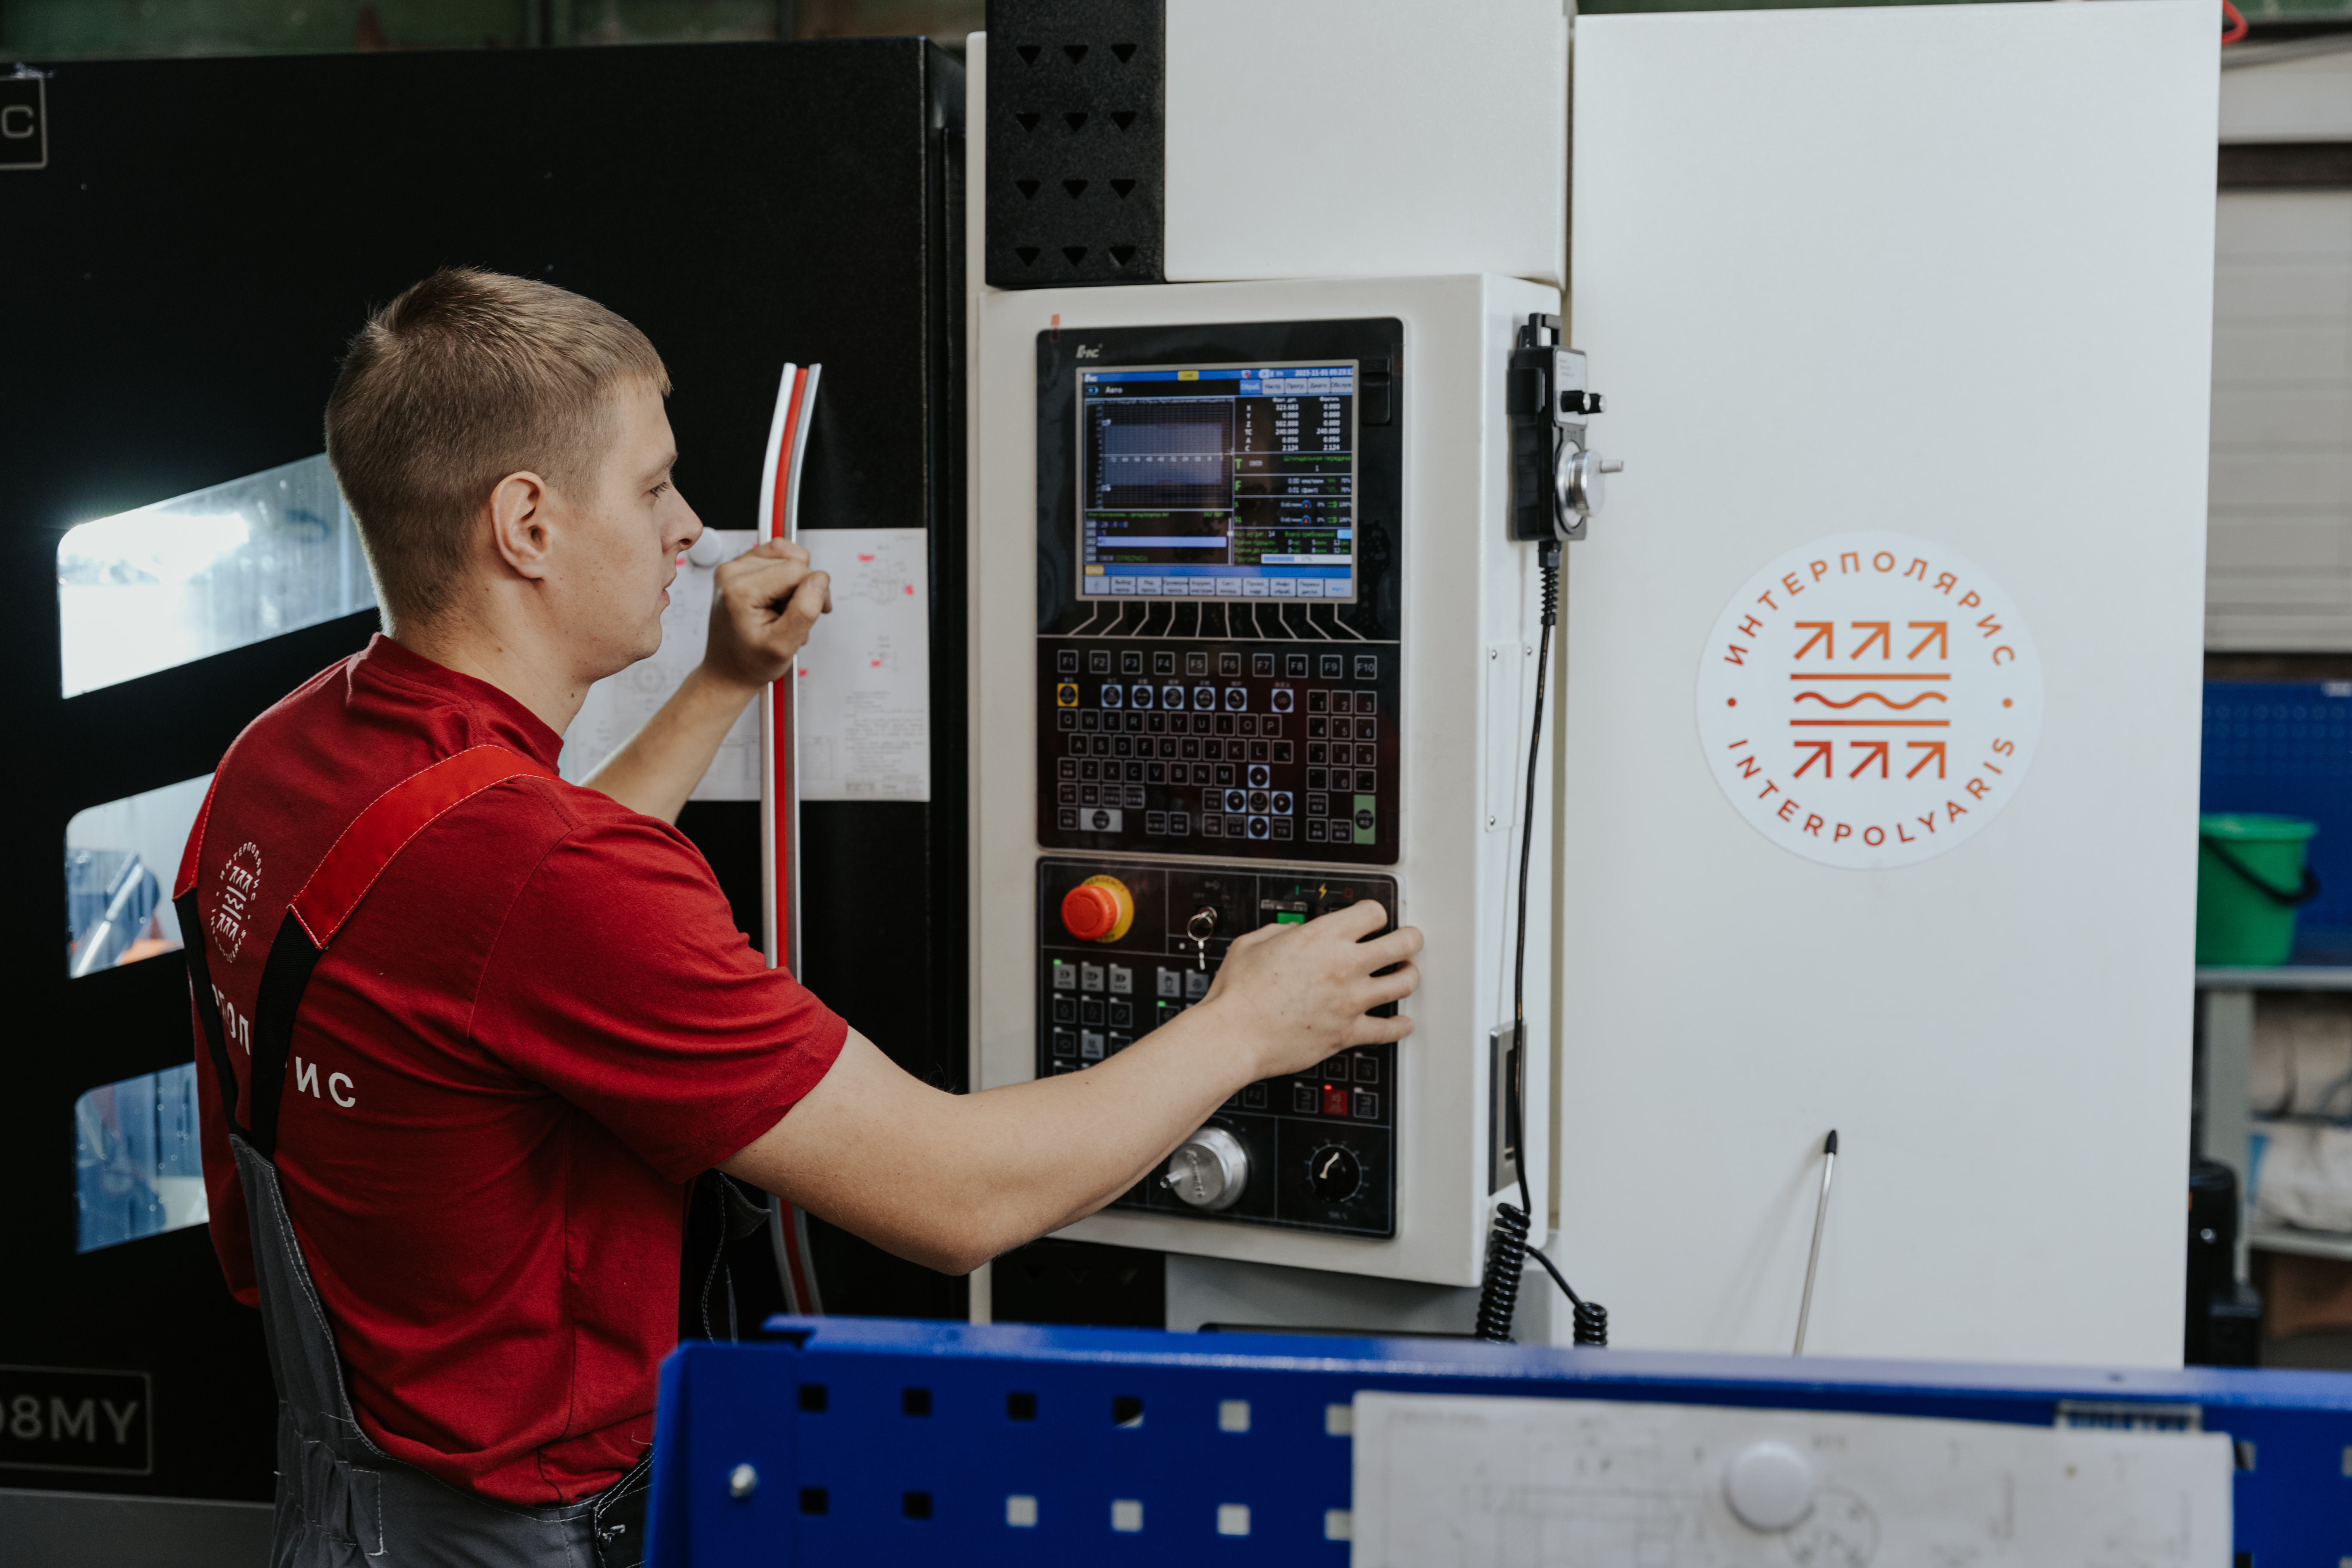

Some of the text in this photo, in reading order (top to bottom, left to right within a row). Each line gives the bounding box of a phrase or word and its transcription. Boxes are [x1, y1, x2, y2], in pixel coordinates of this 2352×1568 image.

[1235, 458, 1243, 469] T
[1235, 480, 1241, 491] F
[1724, 551, 2015, 667] ИНТЕРПОЛЯРИС
[1063, 657, 1073, 665] F1
[1094, 657, 1105, 666] F2
[1126, 658, 1137, 667] F3
[1158, 658, 1169, 668] F4
[1191, 659, 1203, 668] F5
[1224, 660, 1236, 669] F6
[1257, 661, 1269, 670] F7
[1291, 661, 1303, 671] F8
[1325, 662, 1337, 671] F9
[1357, 662, 1375, 672] F10
[1342, 701, 1348, 710] 2
[1366, 701, 1372, 710] 3
[1064, 715, 1072, 725] Q
[1085, 716, 1094, 725] W
[1108, 716, 1115, 726] E
[1130, 717, 1138, 726] R
[1153, 717, 1160, 726] T
[1175, 718, 1182, 727] Y
[1198, 719, 1205, 728] U
[1243, 720, 1252, 729] O
[1267, 721, 1274, 730] P
[1342, 727, 1348, 736] 5
[1366, 728, 1372, 737] 6
[1075, 741, 1082, 749] A
[1097, 741, 1104, 750] S
[1119, 742, 1127, 751] D
[1142, 743, 1148, 751] F
[1164, 743, 1172, 752] G
[1187, 744, 1194, 753] H
[1211, 745, 1216, 754] J
[1232, 746, 1239, 755] K
[1256, 747, 1262, 756] L
[1318, 752, 1324, 760] 7
[1341, 753, 1348, 762] 8
[1366, 754, 1372, 763] 9
[1087, 765, 1093, 775] Z
[1109, 766, 1115, 775] X
[1130, 767, 1138, 776] C
[1153, 768, 1160, 777] V
[1176, 769, 1182, 778] B
[1198, 770, 1205, 779] N
[1220, 771, 1229, 780] M
[1728, 738, 2015, 846] INTERPOLYARIS
[0, 1394, 140, 1445] 8MY
